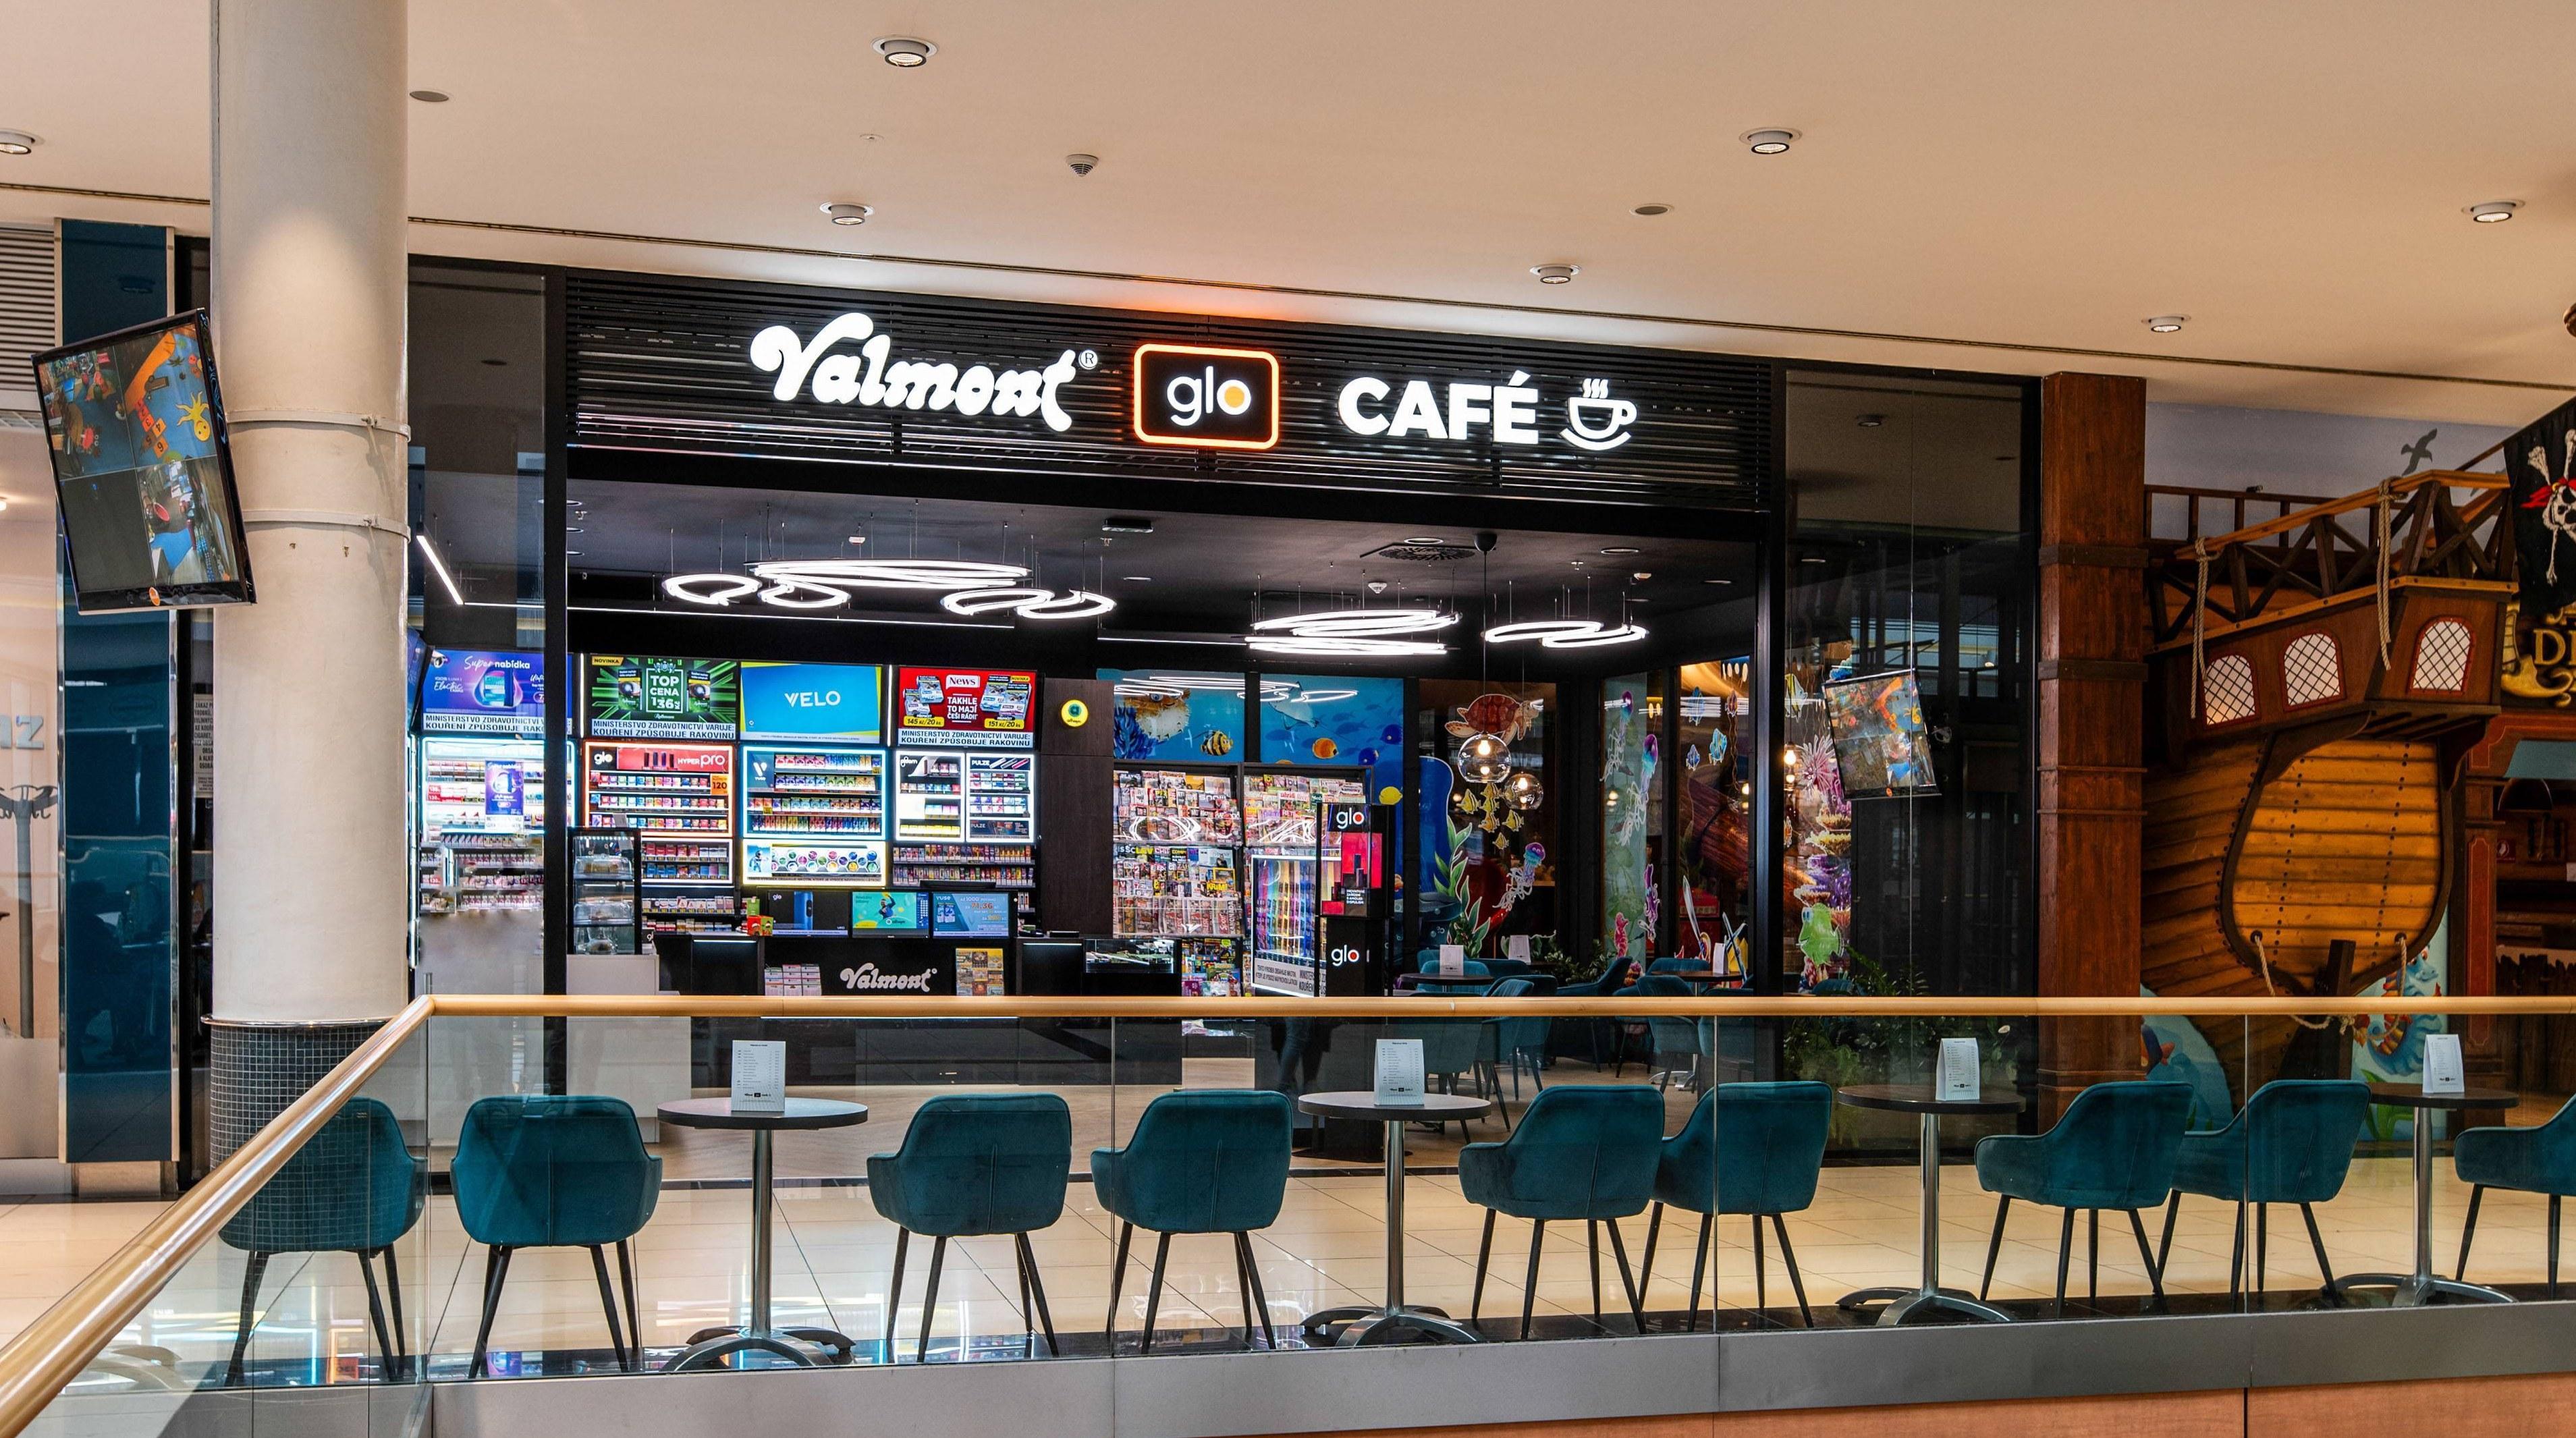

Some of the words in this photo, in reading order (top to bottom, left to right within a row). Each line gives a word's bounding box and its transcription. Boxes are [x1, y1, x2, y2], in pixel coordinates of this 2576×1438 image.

[1167, 366, 1251, 426] glo
[1338, 369, 1539, 445] CAFÉ
[464, 655, 495, 671] Super
[495, 659, 530, 669] nabídka
[650, 675, 680, 687] TOP
[950, 676, 976, 686] News
[649, 688, 680, 696] CENA
[784, 690, 841, 707] VELO
[947, 696, 978, 704] TAKHLE
[958, 704, 978, 713] MAJÍ
[426, 715, 481, 723] MINISTERSTVO
[483, 716, 539, 725] ZDRAVOTNICTVÍ
[426, 721, 466, 730] KOUŘENÍ
[468, 723, 520, 731] ZPŮSOBUJE
[593, 720, 647, 729] MINISTERSTVO
[649, 721, 704, 729] ZDRAVOTNICTVÍ
[705, 723, 734, 731] VARUJE:
[593, 728, 632, 736] KOUŘENÍ
[636, 729, 687, 738] ZPŮSOBUJE
[690, 731, 734, 739] RAKOVINU
[594, 751, 613, 765] glo
[677, 757, 701, 765] HYPER
[701, 754, 725, 768] pro
[712, 781, 728, 790] 120
[1336, 807, 1365, 830] glo
[1331, 944, 1360, 966] glo
[840, 963, 931, 993] Valmont
